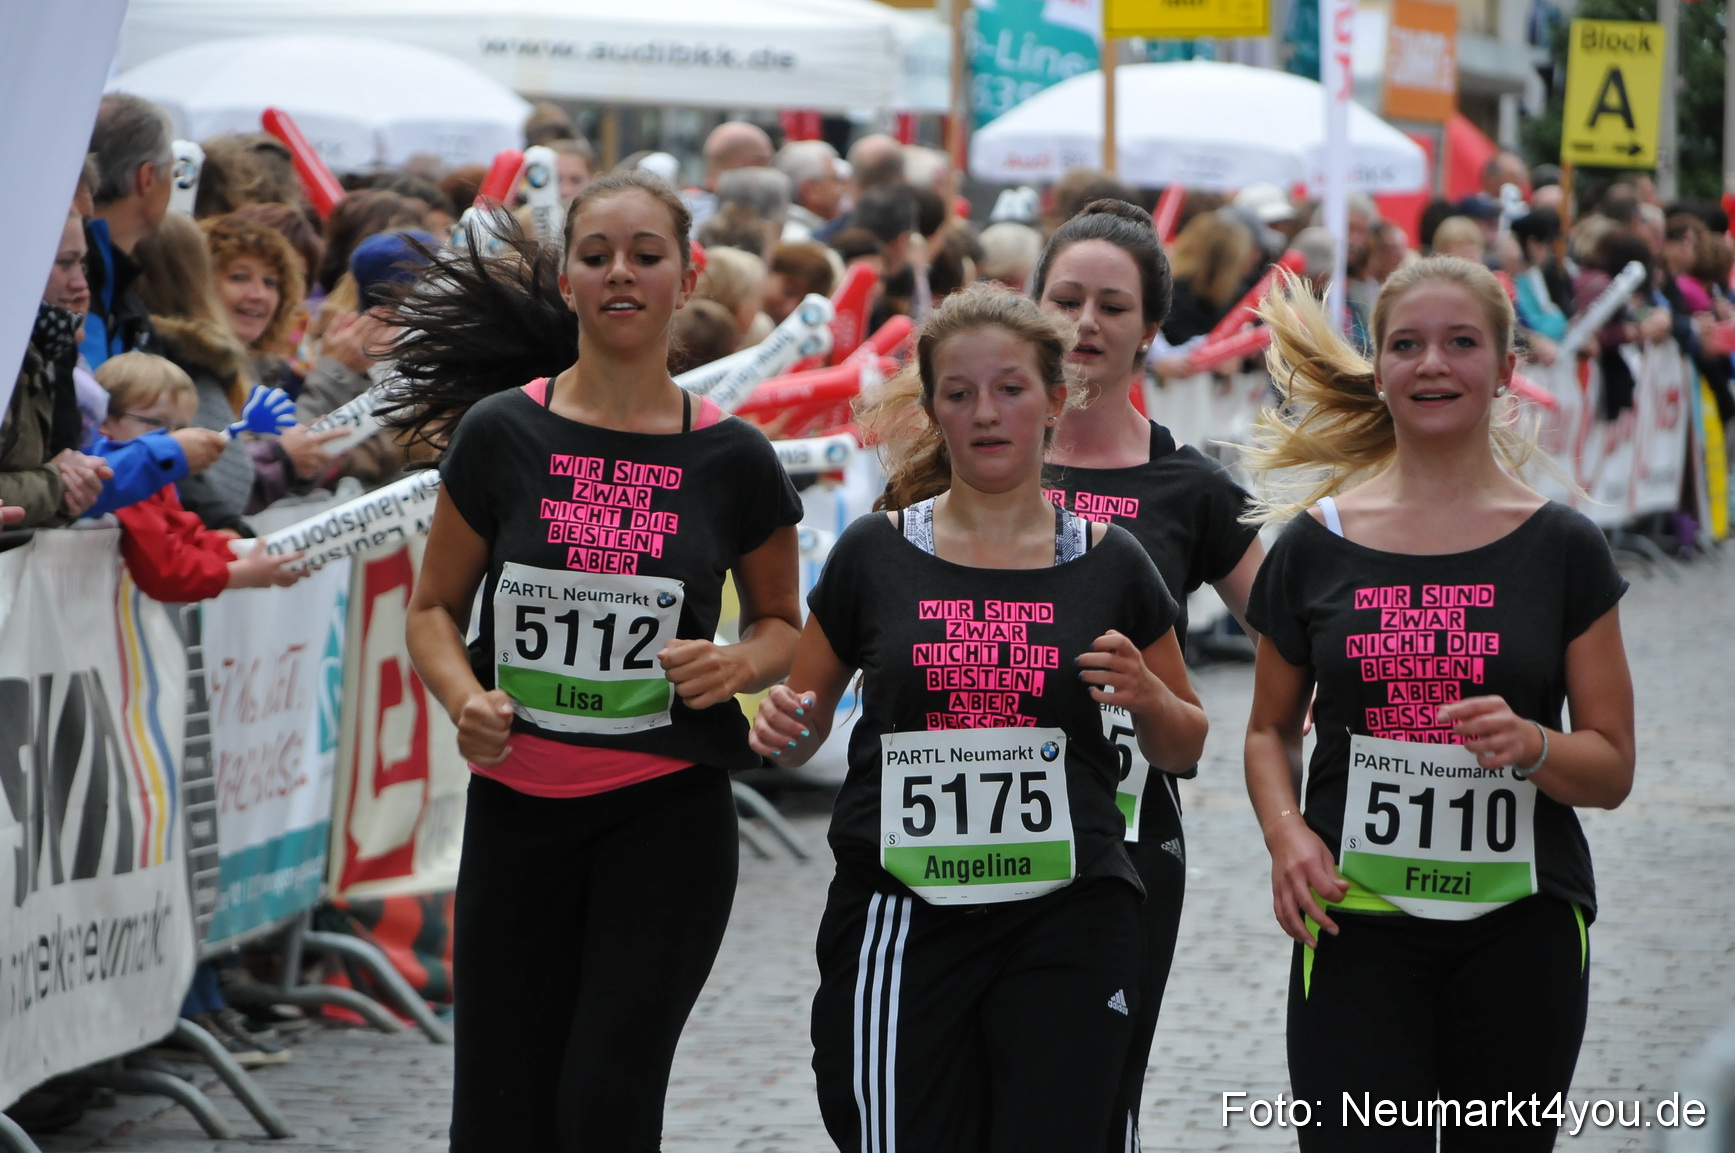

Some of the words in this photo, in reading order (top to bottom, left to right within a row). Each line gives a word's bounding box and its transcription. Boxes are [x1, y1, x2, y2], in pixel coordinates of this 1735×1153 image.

[1580, 24, 1652, 52] Block
[1587, 63, 1635, 129] A
[551, 455, 603, 480] WIR
[614, 461, 681, 488] SIND
[574, 480, 651, 509] ZWAR
[1076, 492, 1137, 517] SIND
[541, 499, 620, 527] NICHT
[632, 511, 677, 533] DIE
[549, 523, 662, 558] BESTEN,
[568, 547, 637, 574] ABER
[500, 579, 558, 600] PARTL
[563, 586, 650, 607] Neumarkt
[1356, 586, 1410, 609] WIR
[1423, 585, 1493, 607] SIND
[920, 601, 973, 619] WIR
[985, 601, 1052, 622] SIND
[1382, 609, 1464, 630] ZWAR
[514, 604, 660, 671] 5112
[947, 620, 1026, 643] ZWAR
[1347, 632, 1434, 657] NICHT
[1448, 632, 1498, 654] DIE
[914, 643, 998, 666] NICHT
[1010, 645, 1058, 668] DIE
[928, 667, 1044, 696] BESTEN,
[1362, 657, 1483, 683] BESTEN,
[555, 683, 603, 711] Lisa
[949, 693, 1019, 714] ABER
[1388, 681, 1459, 703] ABER
[1099, 702, 1126, 717] arkt
[887, 750, 945, 765] PARTL
[950, 746, 1033, 763] Neumarkt
[1354, 752, 1415, 775] PARTL
[1420, 761, 1505, 779] Neumarkt
[902, 771, 1052, 837] 5175
[1364, 781, 1516, 853] 5110
[924, 853, 1031, 884] Angelina
[1405, 867, 1472, 895] Frizzi
